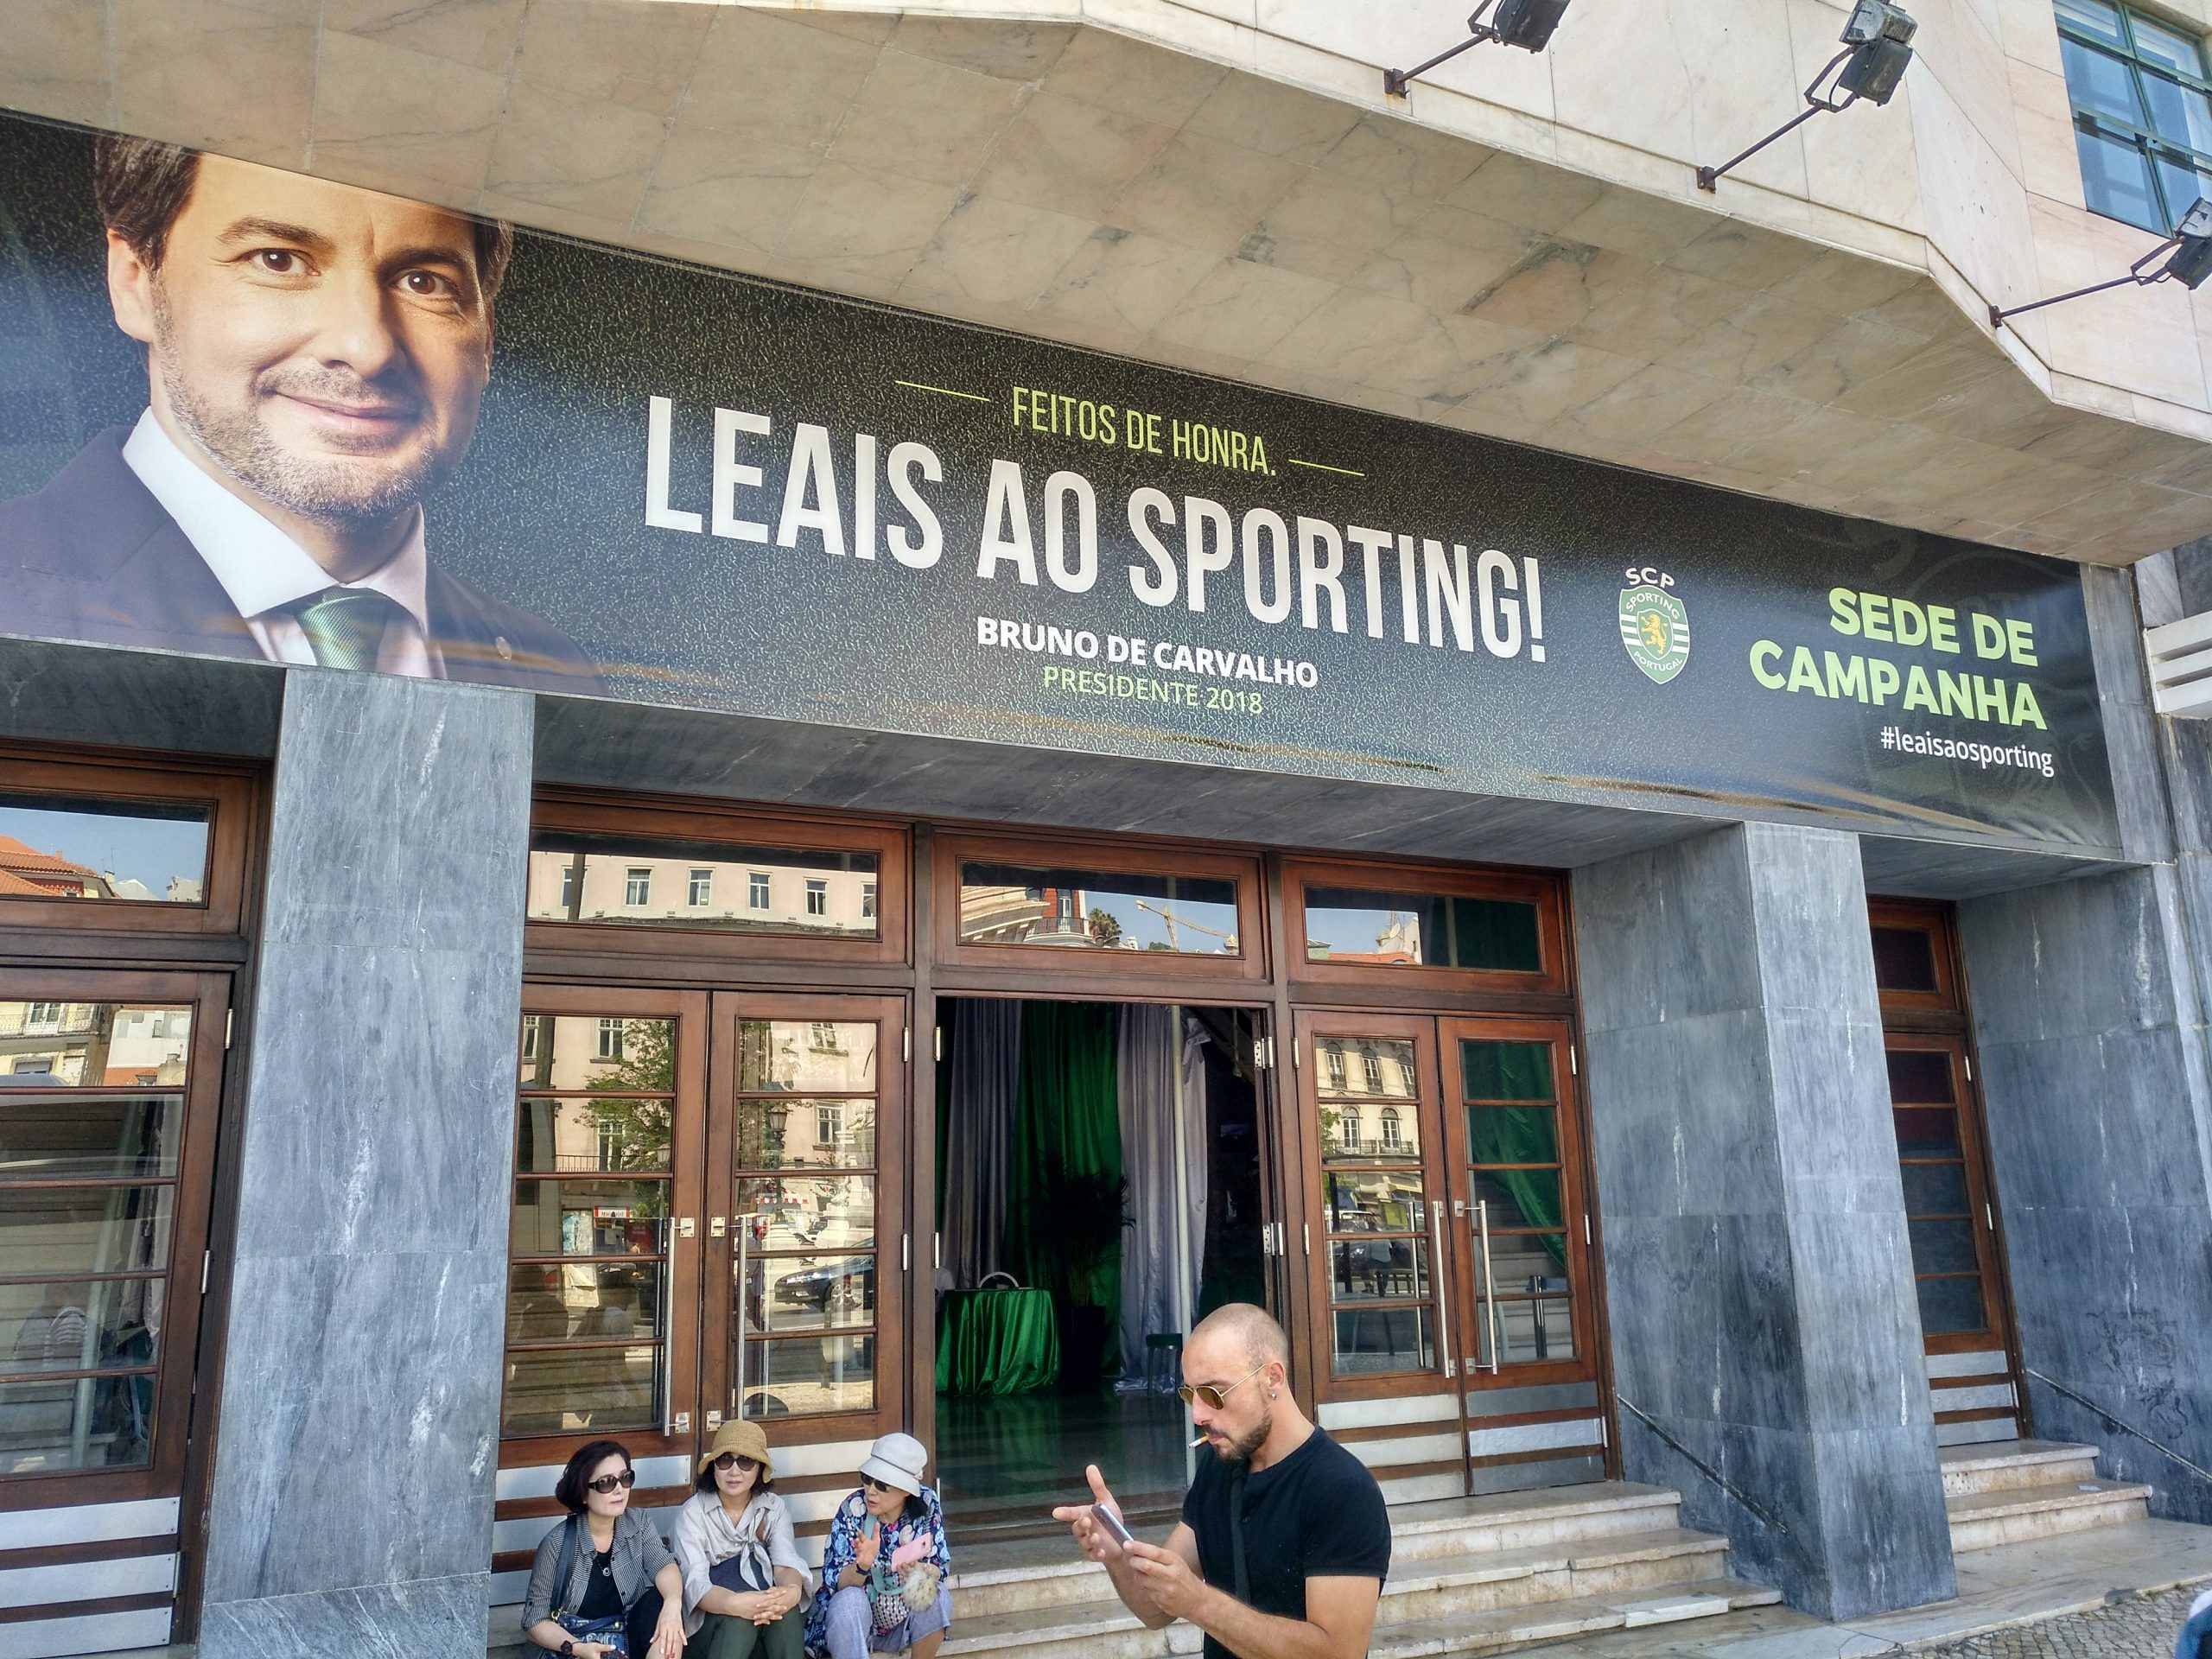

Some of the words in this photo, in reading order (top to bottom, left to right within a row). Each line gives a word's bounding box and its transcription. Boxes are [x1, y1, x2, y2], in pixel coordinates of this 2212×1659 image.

[1013, 386, 1116, 444] FEITOS
[1127, 410, 1163, 454] DE
[1173, 418, 1277, 476] HONRA.
[645, 395, 944, 569] LEAIS
[976, 458, 1099, 594] AO
[1127, 486, 1547, 664] SPORTING!
[1625, 567, 1675, 588] SCP
[1625, 592, 1681, 620] SPORTING
[976, 616, 1100, 659] BRUNO
[1107, 635, 1147, 666] DE
[1154, 642, 1319, 689] CARVALHO
[1828, 587, 1961, 654] SEDE
[1971, 612, 2039, 667] DE
[1043, 665, 1199, 707] PRESIDENTE
[1205, 687, 1264, 715] 2018
[1633, 651, 1683, 672] PORTUGAL
[1748, 639, 2049, 731] CAMPANHA
[1879, 725, 2056, 778] #leaisaosporting
